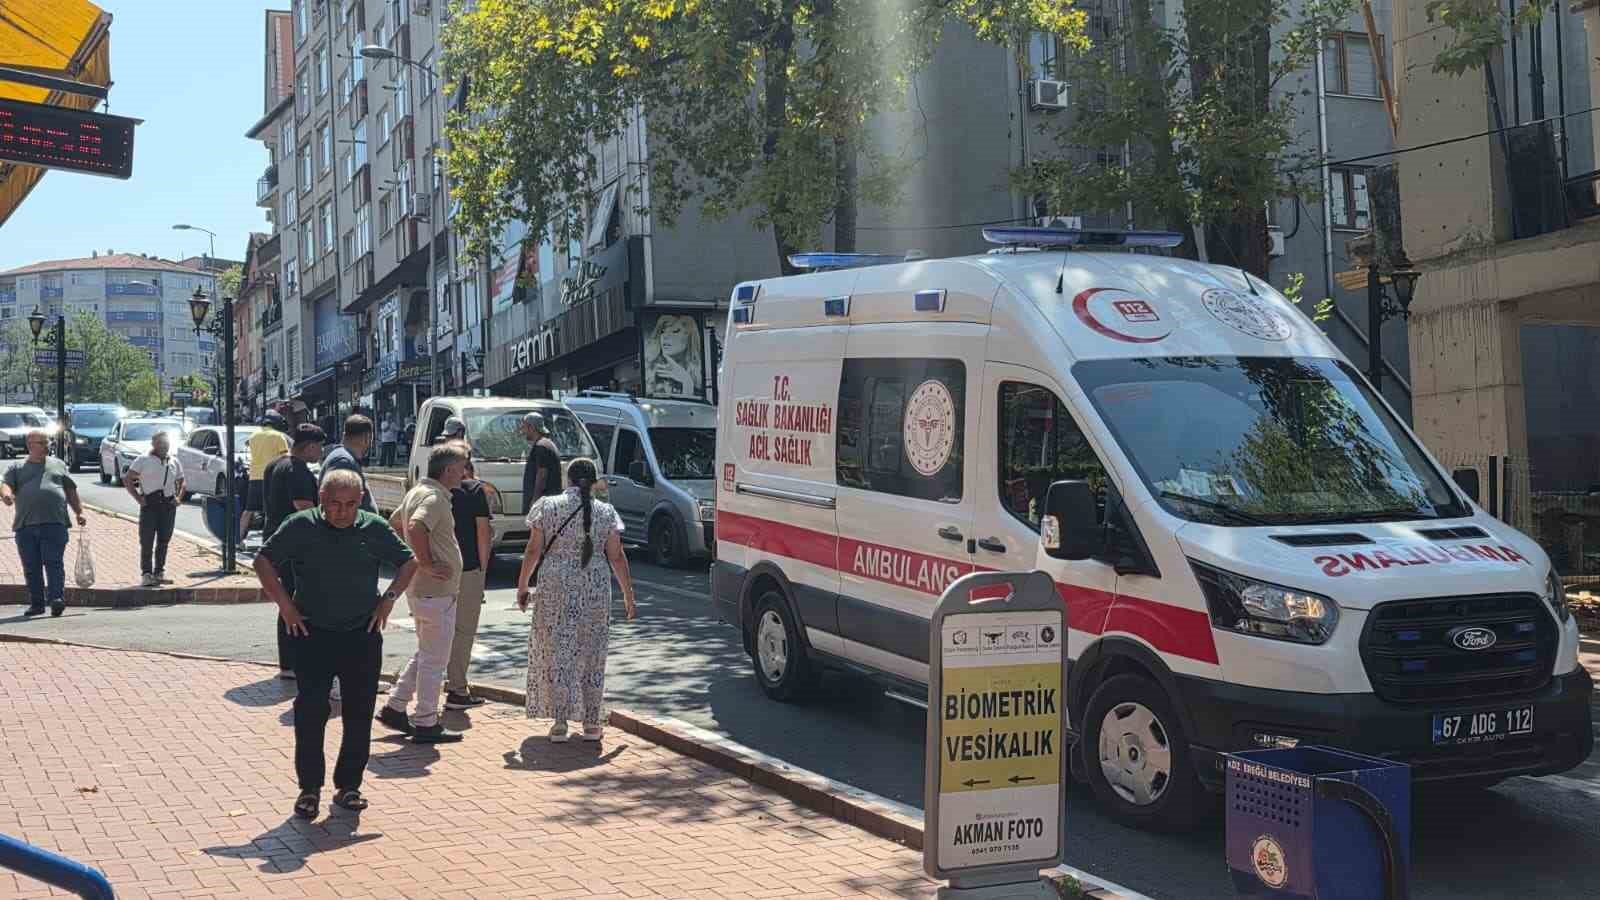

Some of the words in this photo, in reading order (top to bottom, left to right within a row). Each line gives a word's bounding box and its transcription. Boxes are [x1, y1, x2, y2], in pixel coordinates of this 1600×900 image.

[1120, 302, 1151, 314] 112
[510, 328, 555, 373] zemin
[773, 375, 791, 401] T.C.
[736, 401, 769, 429] SAĞLIK
[773, 403, 832, 435] BAKANLIĞI
[749, 431, 771, 461] ACİL
[774, 435, 812, 467] SAĞLIK
[853, 545, 960, 595] AMBULANS
[1462, 631, 1490, 648] Ford
[945, 683, 1056, 721] BİOMETRİK
[1443, 716, 1462, 738] 67
[1470, 713, 1497, 736] ADG
[1506, 709, 1531, 731] 112
[946, 728, 1053, 762] VESİKALIK
[1268, 769, 1310, 787] BELEDİYESİ
[953, 821, 1003, 846] AKMAN
[1007, 817, 1043, 841] FOTO
